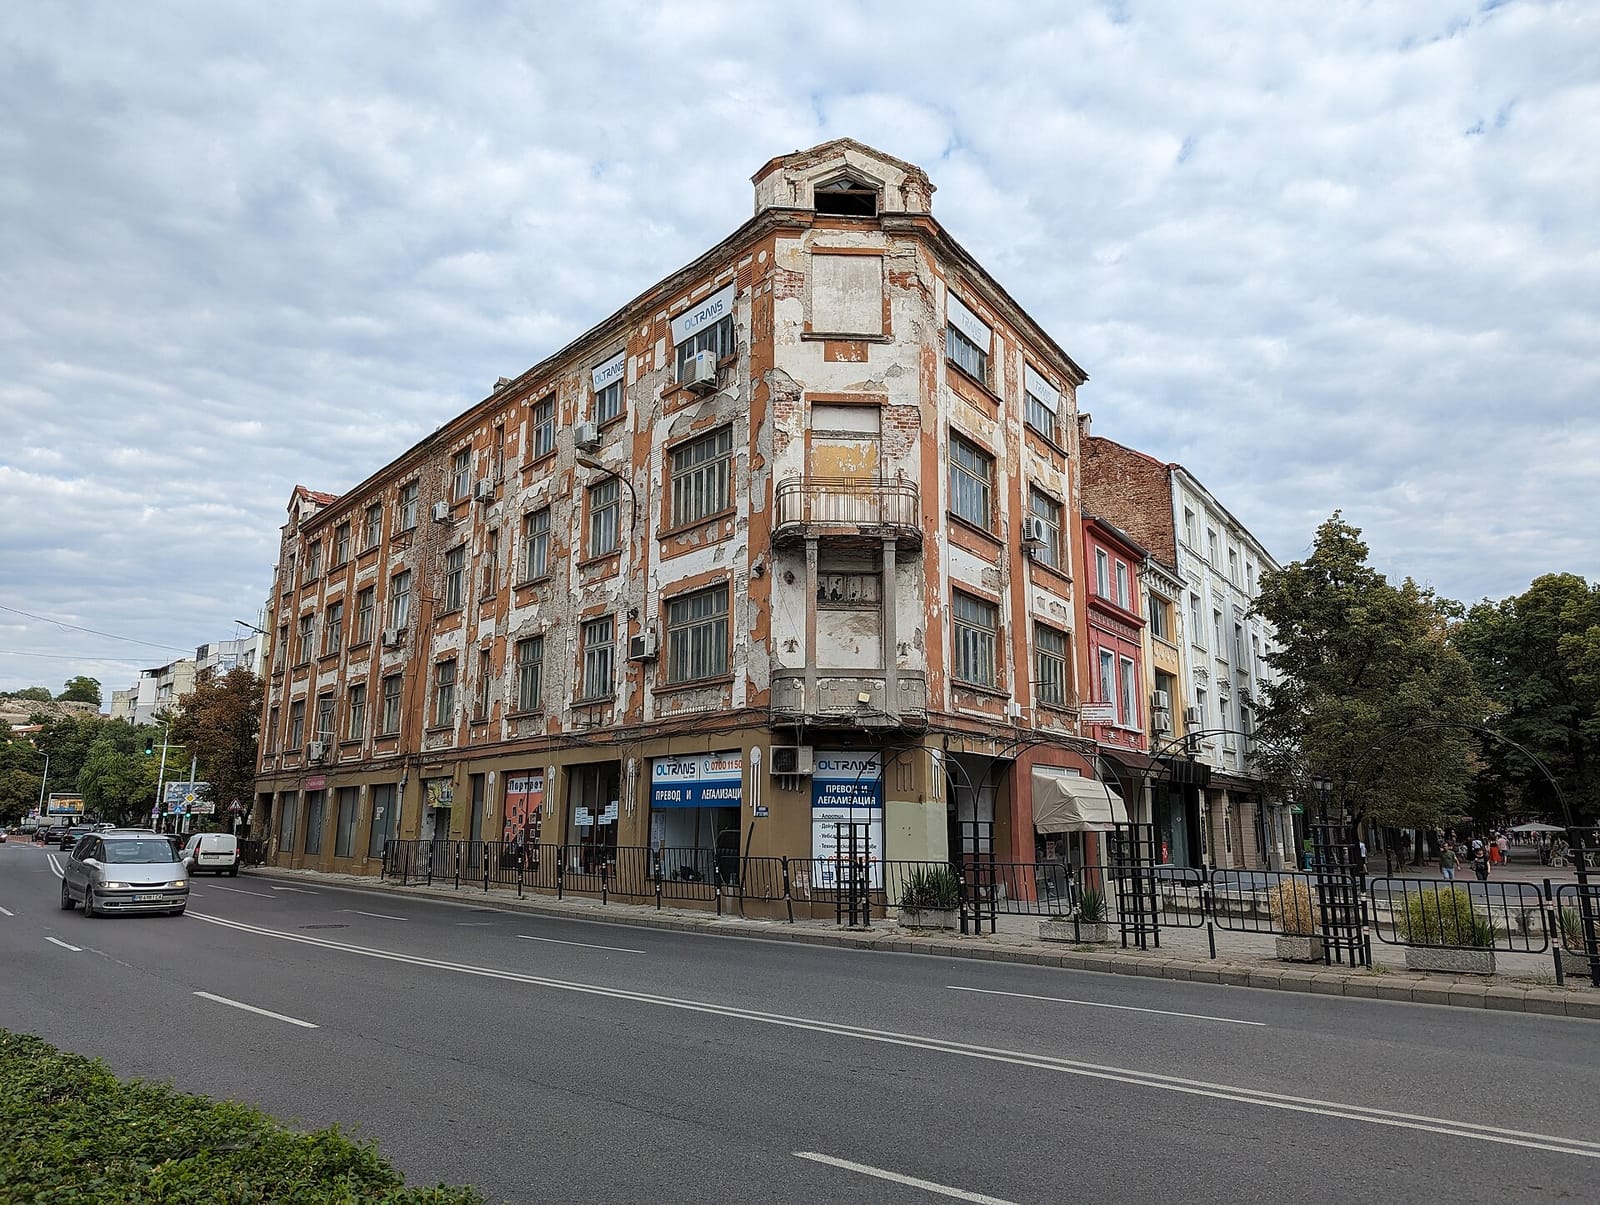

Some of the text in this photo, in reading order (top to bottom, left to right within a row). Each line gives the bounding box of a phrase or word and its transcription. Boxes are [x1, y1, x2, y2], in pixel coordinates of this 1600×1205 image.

[684, 299, 723, 331] OLTRANS
[656, 762, 695, 776] OLTRANS
[711, 760, 726, 770] 0700
[818, 760, 876, 771] OLTRANS
[655, 790, 681, 802] ПРЕВОД
[686, 789, 692, 800] И
